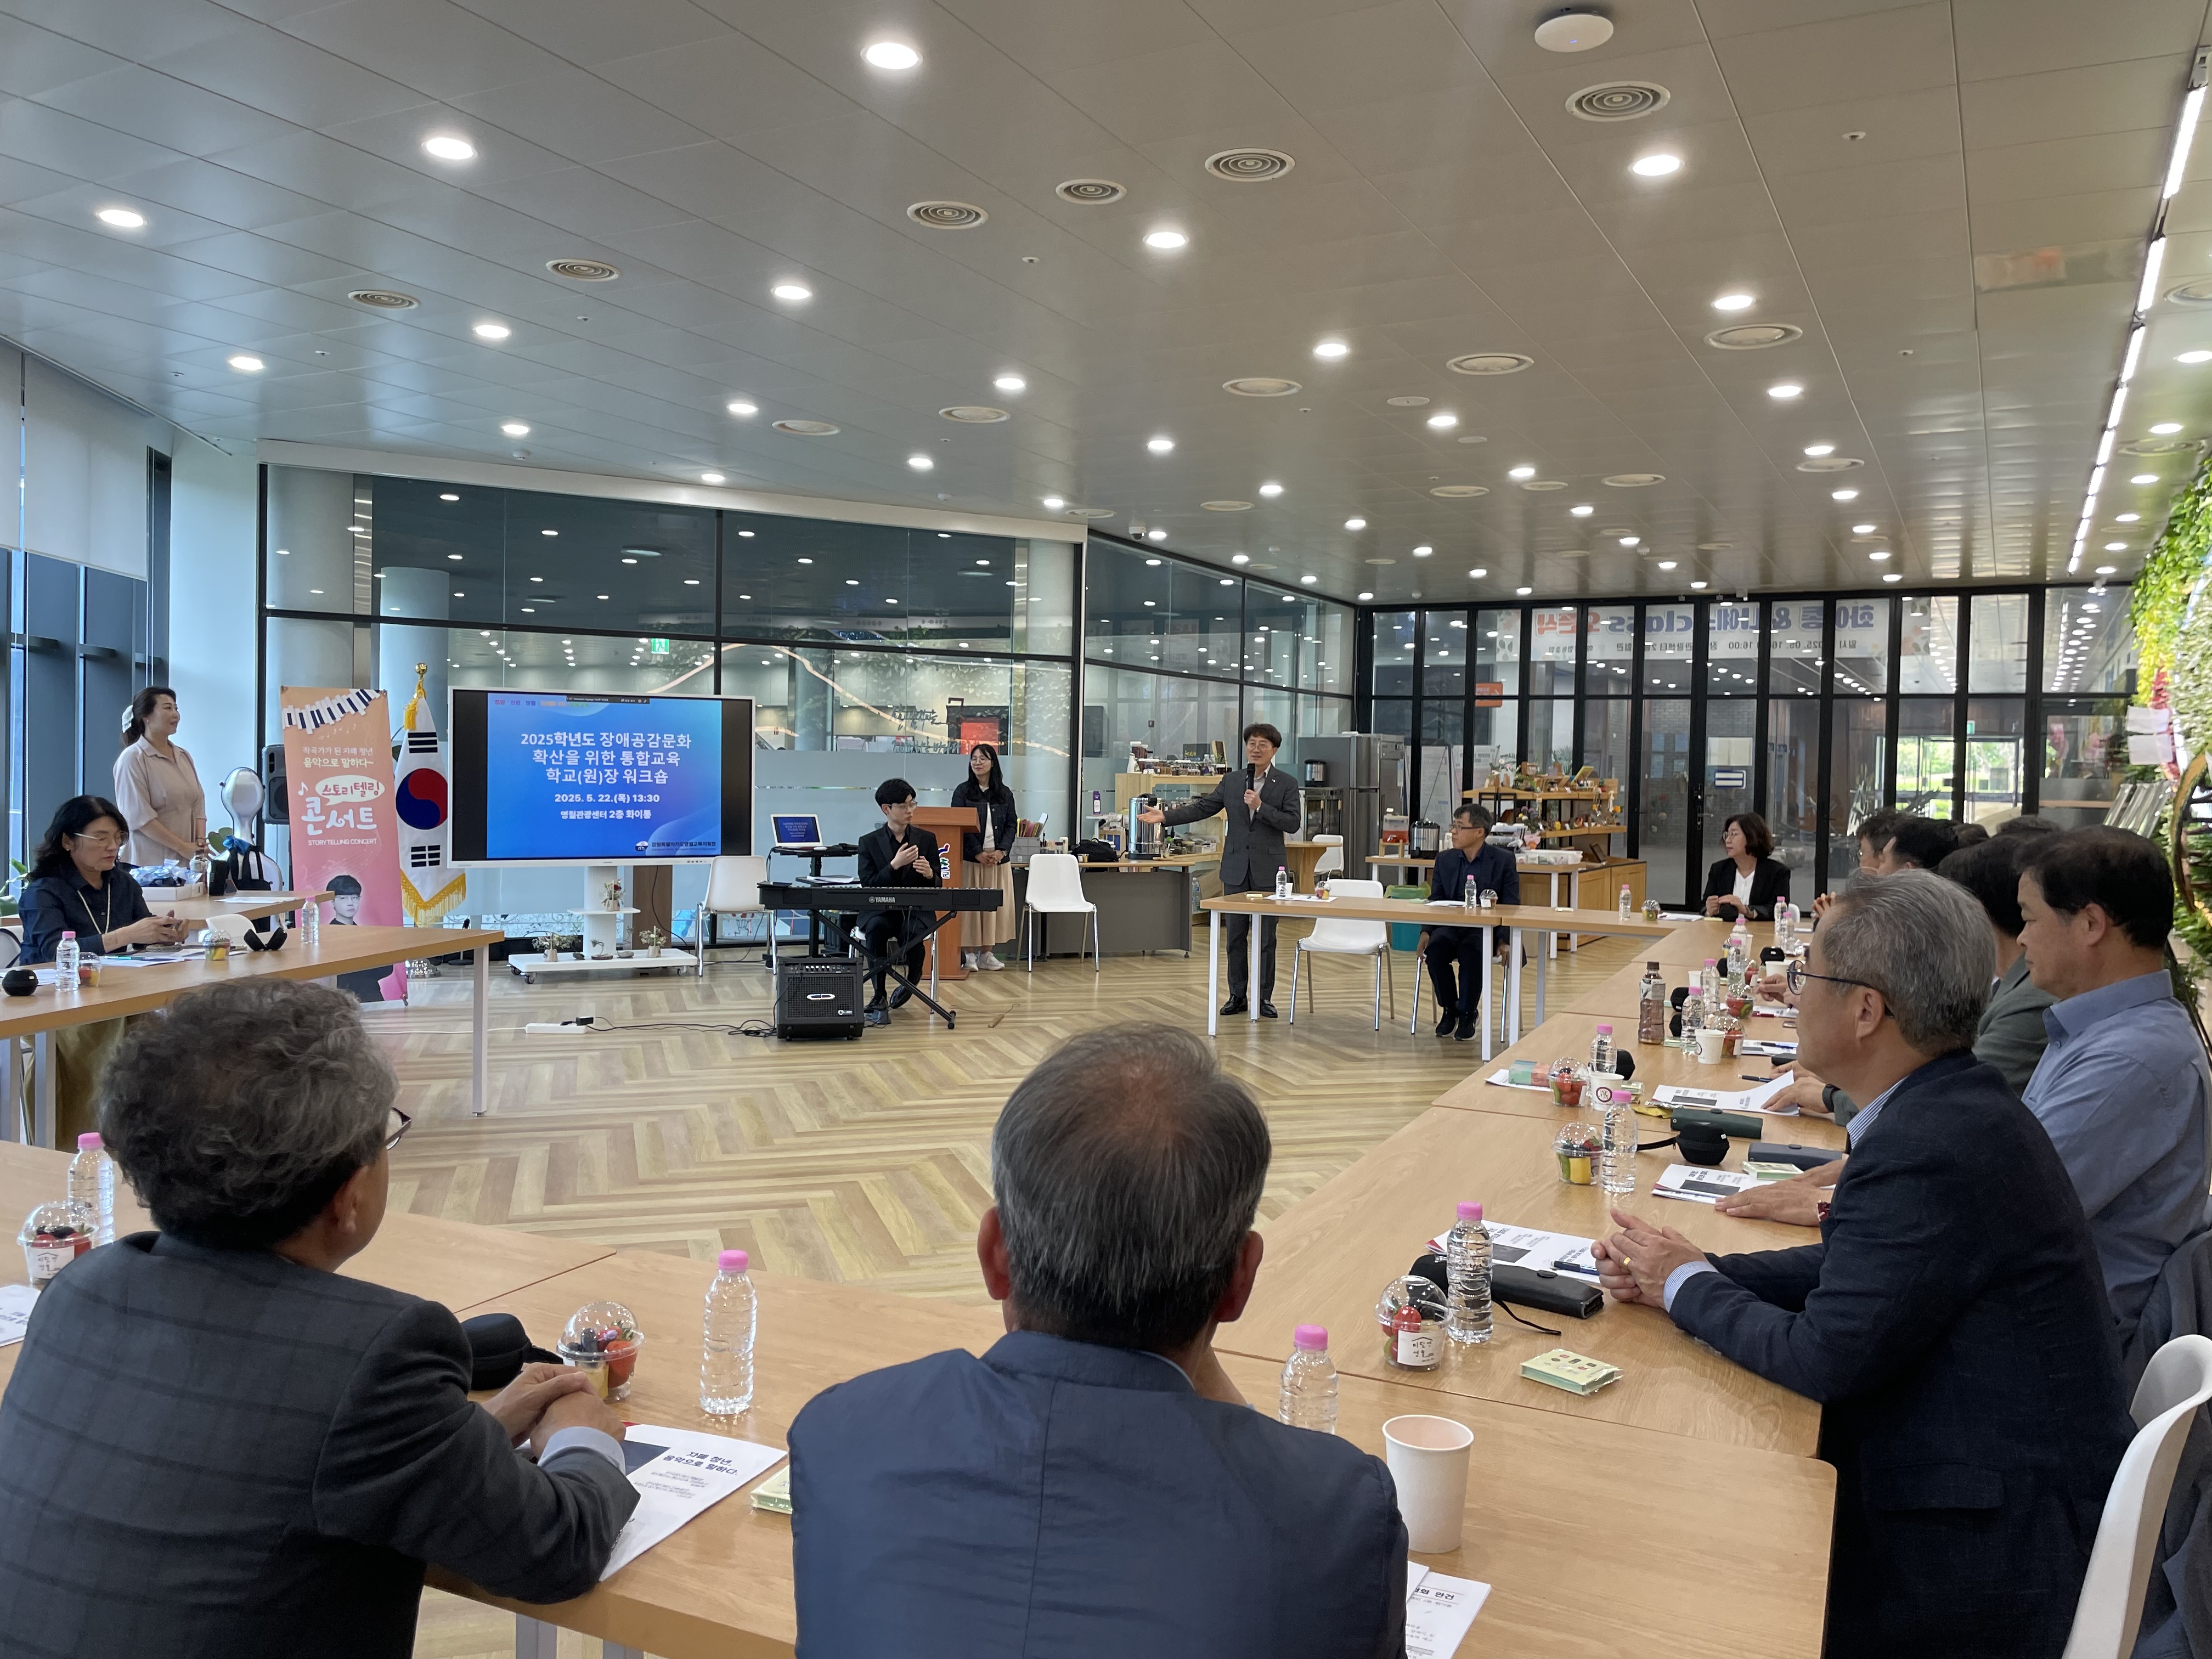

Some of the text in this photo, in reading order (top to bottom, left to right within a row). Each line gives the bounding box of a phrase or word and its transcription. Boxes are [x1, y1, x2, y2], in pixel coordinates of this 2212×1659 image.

[521, 731, 692, 749] 2025학년도 장애공감문화
[303, 746, 373, 756] 작곡가가 된 자폐 청년
[532, 749, 681, 767] 확산을 위한 통합교육
[303, 757, 340, 768] 음악으로
[546, 768, 669, 786] 학교(원)장 워크숍
[321, 781, 380, 798] 스토리텔링
[554, 793, 660, 804] 2025. 5. 22.(목) 13:30
[301, 797, 377, 836] 콘서트
[560, 810, 607, 820] 영월관광센터
[609, 809, 624, 820] 2층
[663, 1455, 704, 1467] 음악으로
